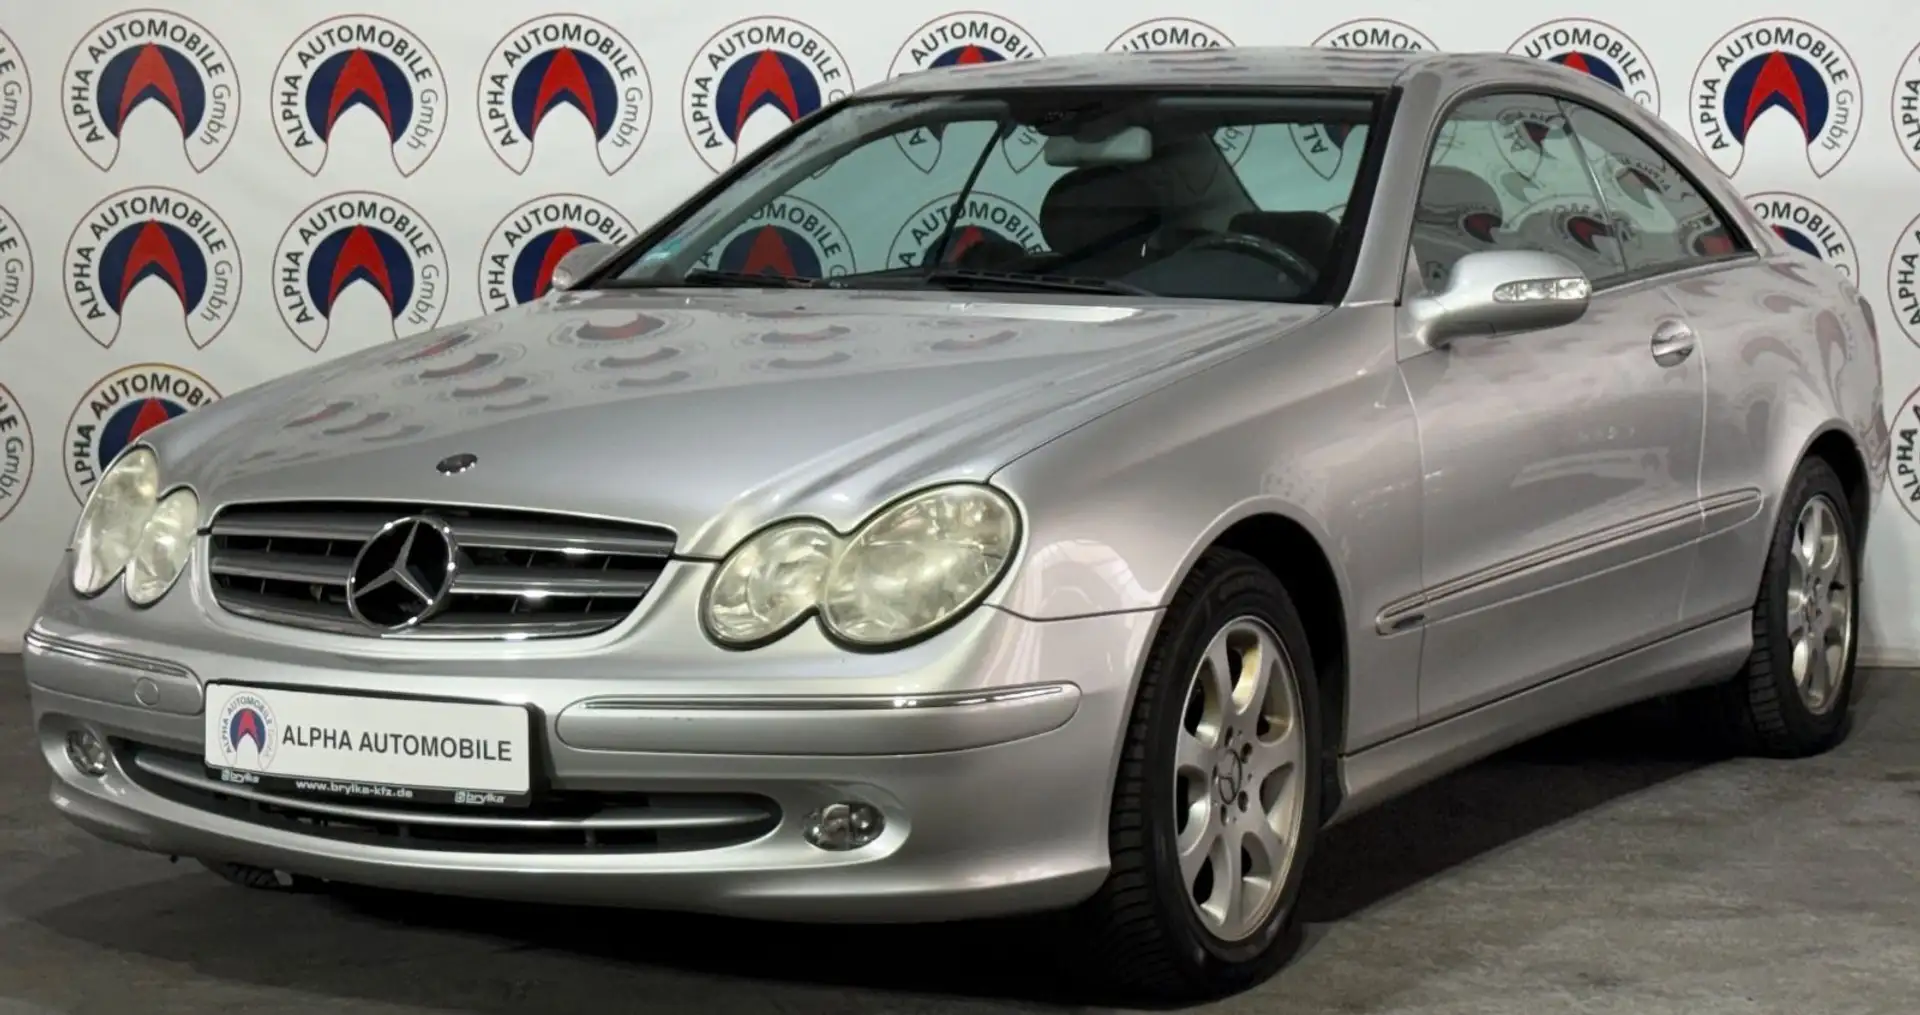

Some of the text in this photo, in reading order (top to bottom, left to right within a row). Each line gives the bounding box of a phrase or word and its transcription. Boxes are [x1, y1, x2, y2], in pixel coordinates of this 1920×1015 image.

[71, 69, 104, 143] ALPHA
[88, 18, 225, 78] AUTOMOBILE
[200, 83, 231, 145] Gmbh
[281, 24, 438, 150] ALPHA AUTOMOBILE Gmbh
[487, 23, 643, 148] ALPHA AUTOMOBILE Gmbh
[691, 25, 841, 149] ALPHA AUTOMOBILE
[1524, 28, 1646, 86] UTOMOBILE
[1698, 27, 1854, 151] ALPHA AUTOMOBILE Gmbh
[89, 196, 227, 254] AUTOMOBILE
[750, 203, 842, 258] OMOBILE
[1754, 201, 1846, 257] OMOBILE
[73, 246, 106, 320] ALPHA
[200, 260, 233, 322] Gmbh
[282, 200, 439, 325] ALPHA AUTOMOBILE Gmbh
[488, 253, 509, 312] LPHA
[74, 424, 96, 487] LPHA
[282, 724, 353, 751] ALPHA
[359, 731, 512, 761] AUTOMOBILE
[296, 780, 413, 798] www.brylka-kfz.de
[465, 791, 505, 804] brylka
